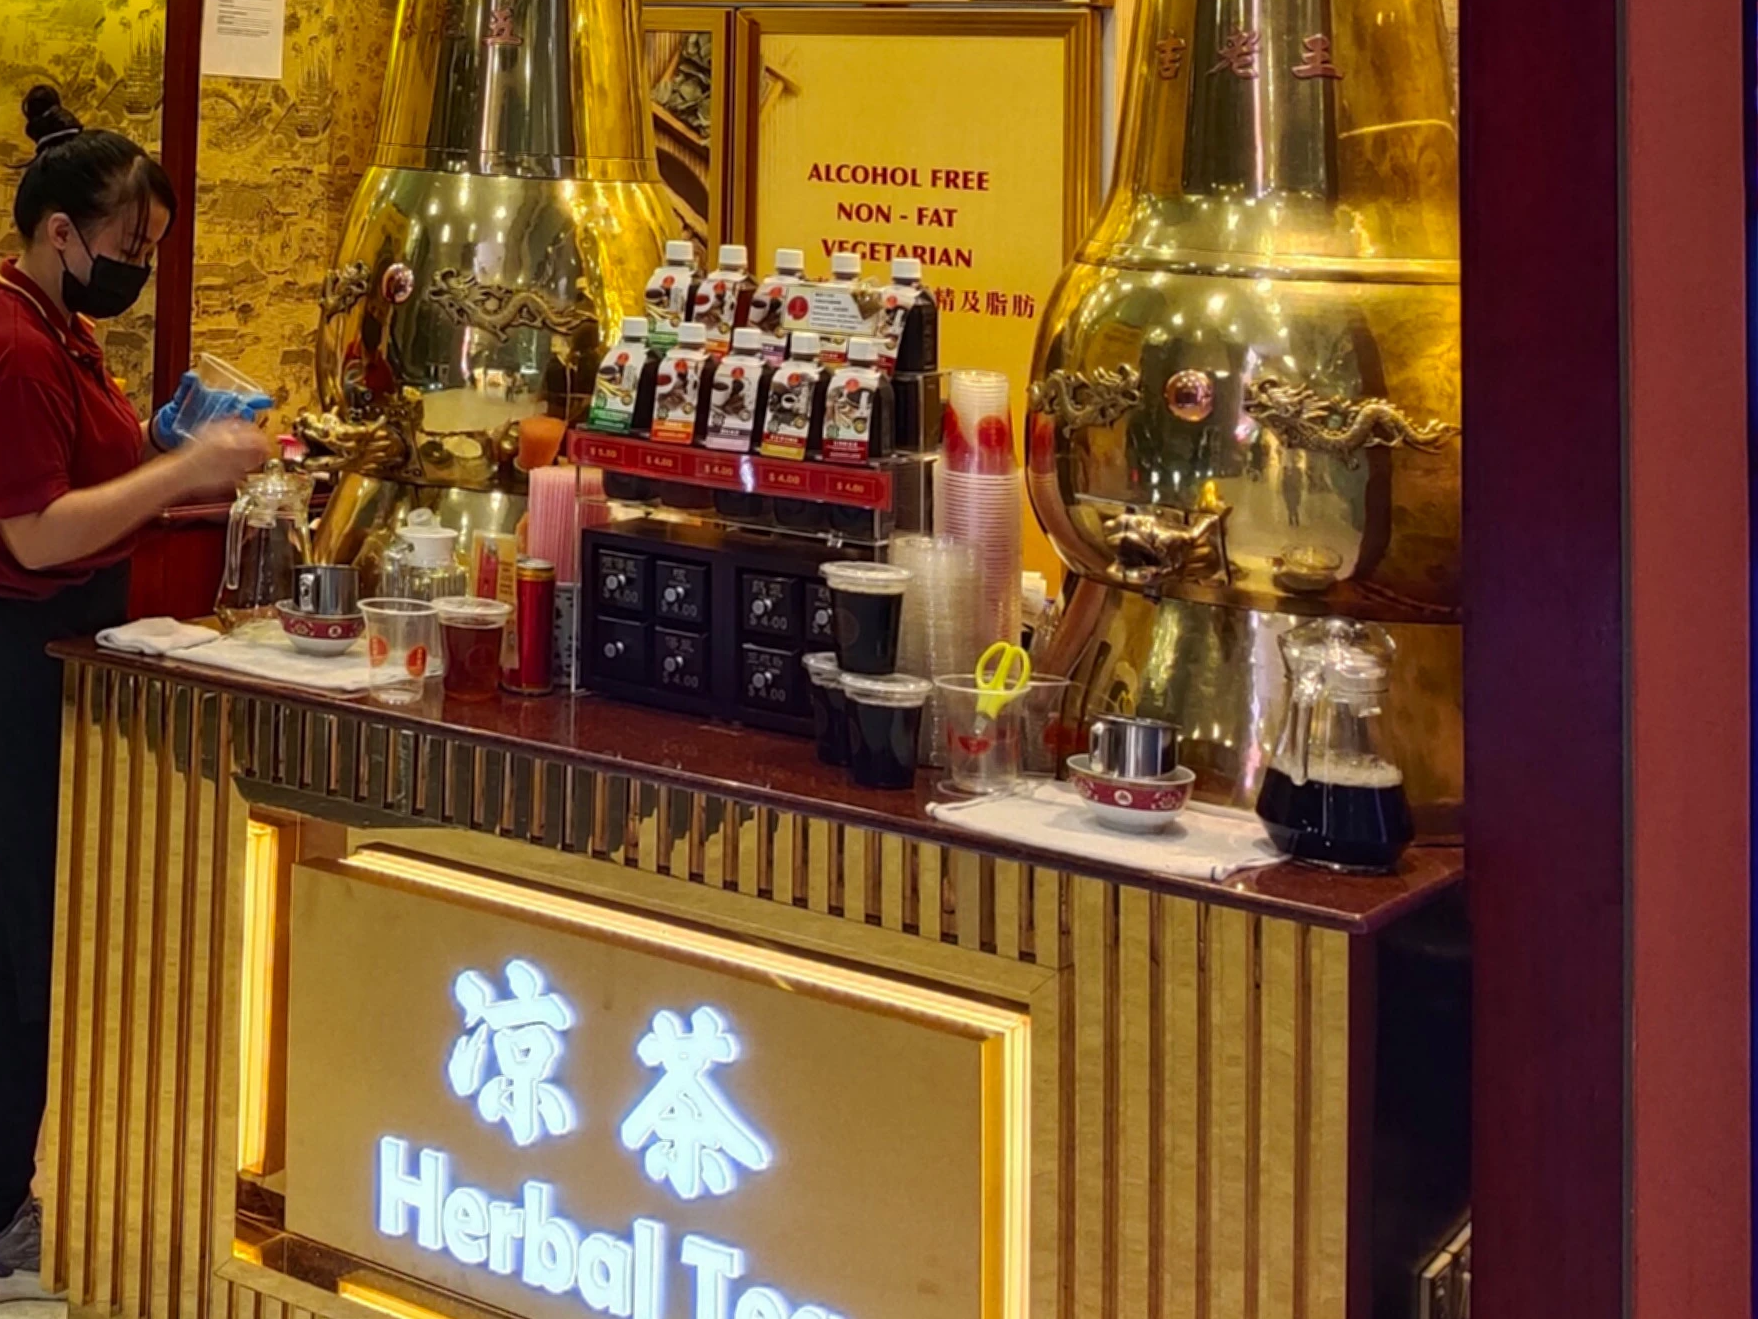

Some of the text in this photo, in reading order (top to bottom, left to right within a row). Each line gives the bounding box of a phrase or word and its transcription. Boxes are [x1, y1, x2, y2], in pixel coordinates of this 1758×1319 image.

[808, 163, 989, 191] ALCOHOL FREE
[837, 202, 891, 223] NON
[916, 207, 958, 228] FAT
[821, 238, 973, 268] VEGETARIAN
[447, 958, 772, 1199] 凉茶
[378, 1135, 665, 1319] Herbal
